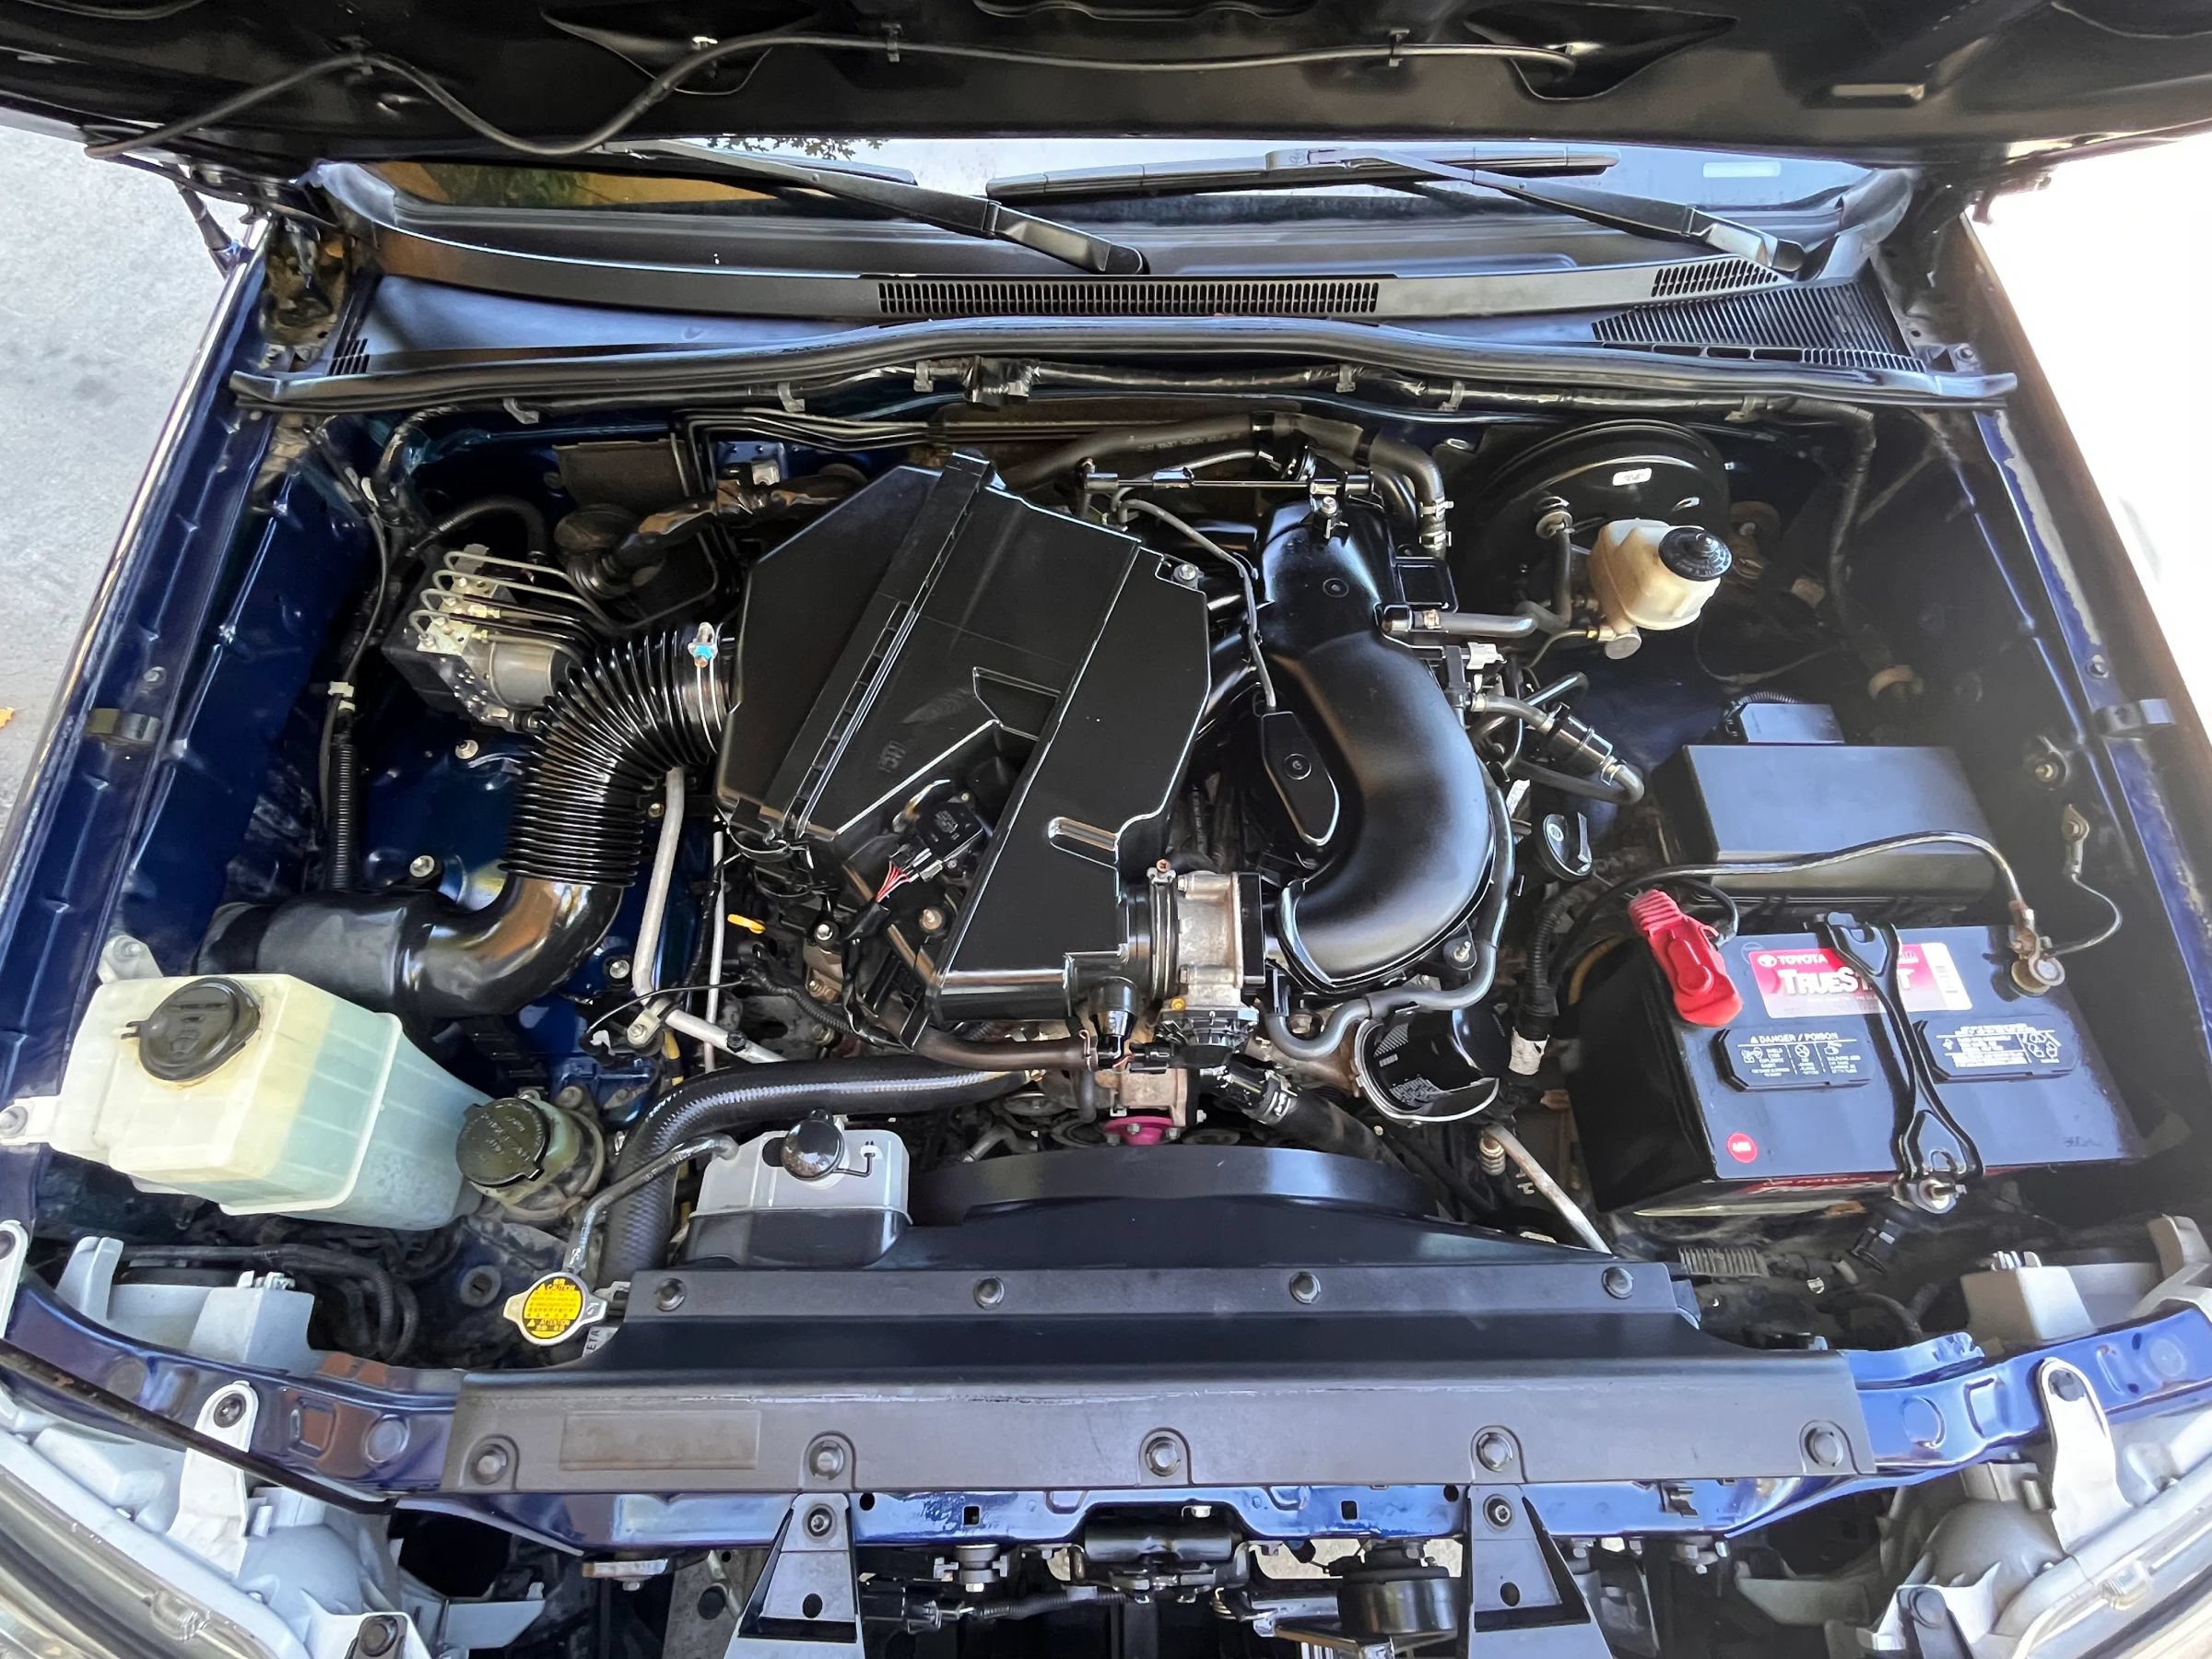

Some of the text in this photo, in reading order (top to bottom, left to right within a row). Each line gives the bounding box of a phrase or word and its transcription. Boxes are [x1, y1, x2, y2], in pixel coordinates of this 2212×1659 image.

[1777, 953, 1829, 965] TOYOTA
[1777, 966, 1915, 995] TRUESTT
[1759, 1033, 1795, 1043] DANGER
[1804, 1031, 1839, 1041] POISON
